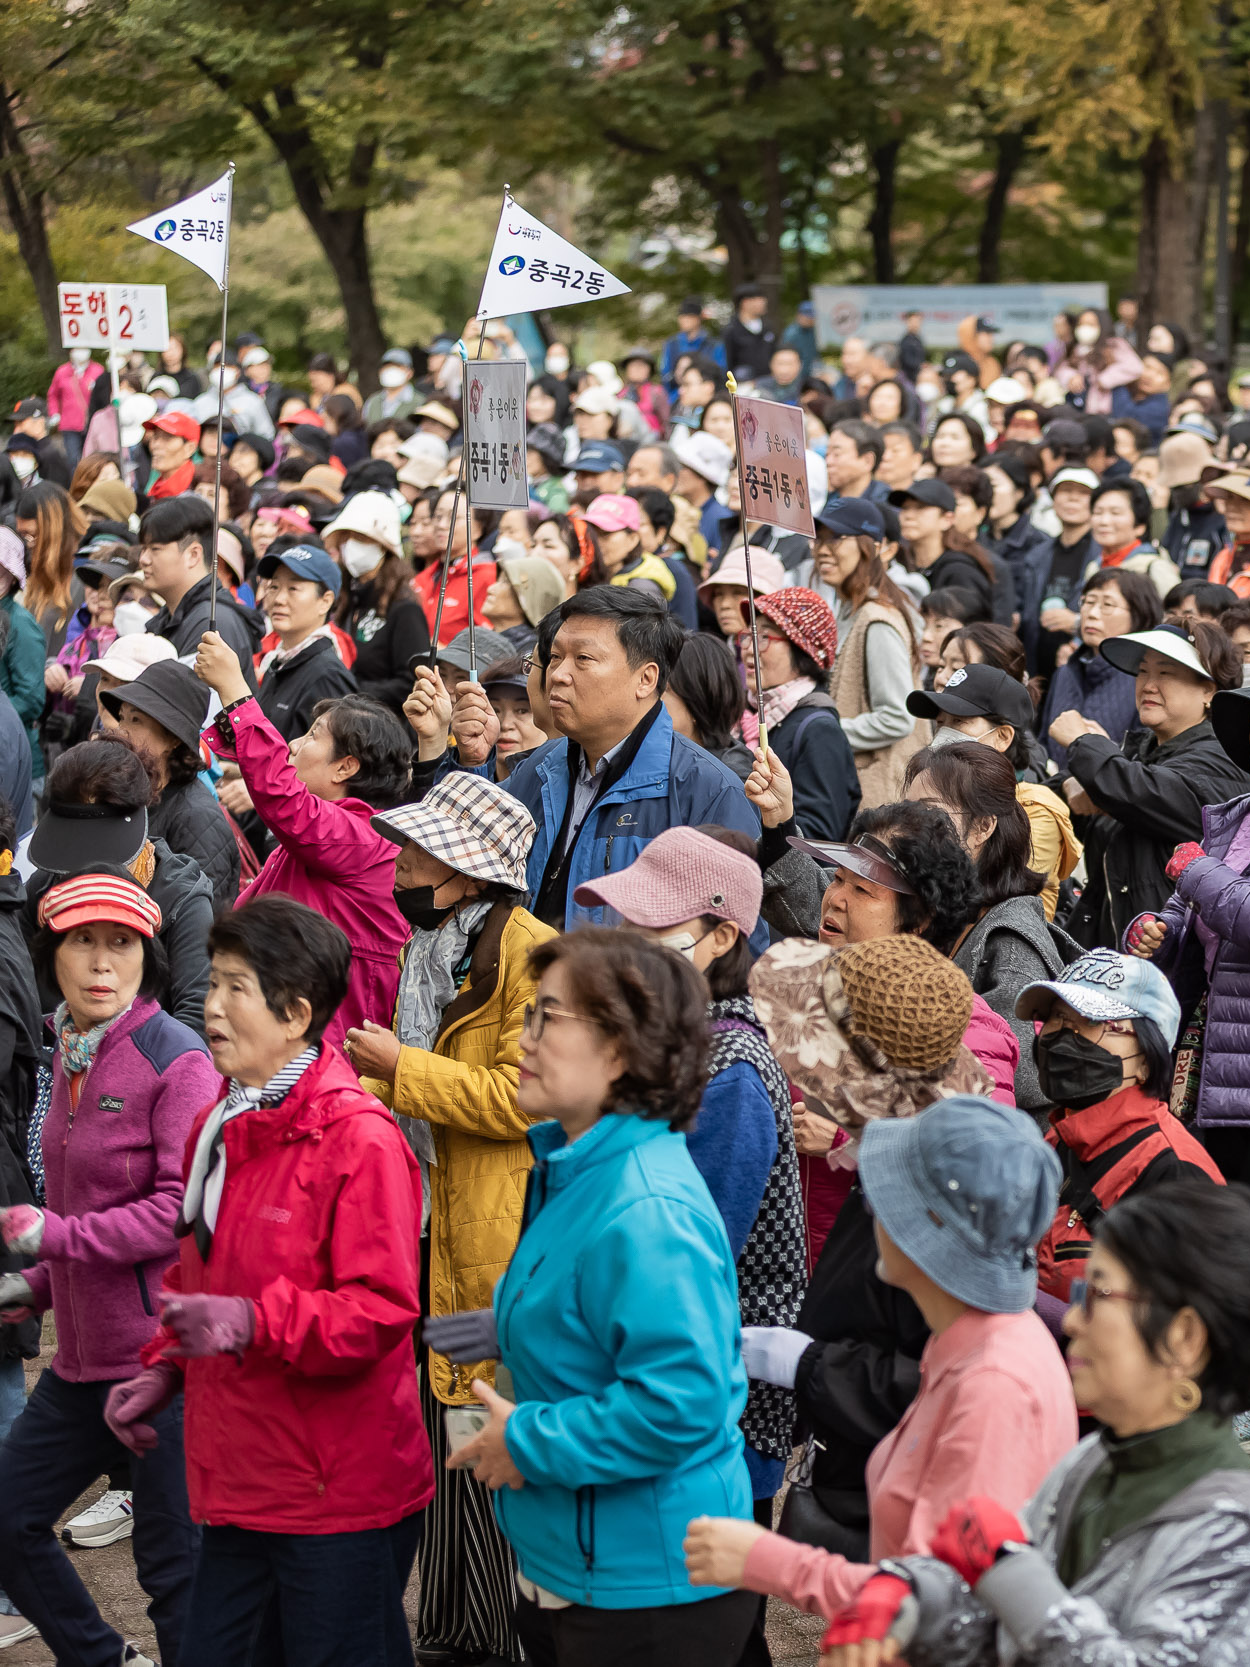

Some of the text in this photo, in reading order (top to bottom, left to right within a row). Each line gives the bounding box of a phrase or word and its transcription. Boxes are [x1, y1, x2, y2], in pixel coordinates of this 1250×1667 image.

[180, 218, 224, 242] 중곡2동
[528, 258, 605, 296] 중곡2동
[60, 291, 109, 338] 동행
[487, 397, 518, 422] 좋은이웃
[470, 441, 509, 484] 중곡1동
[765, 431, 799, 459] 좋은이웃
[745, 464, 792, 509] 중곡1동
